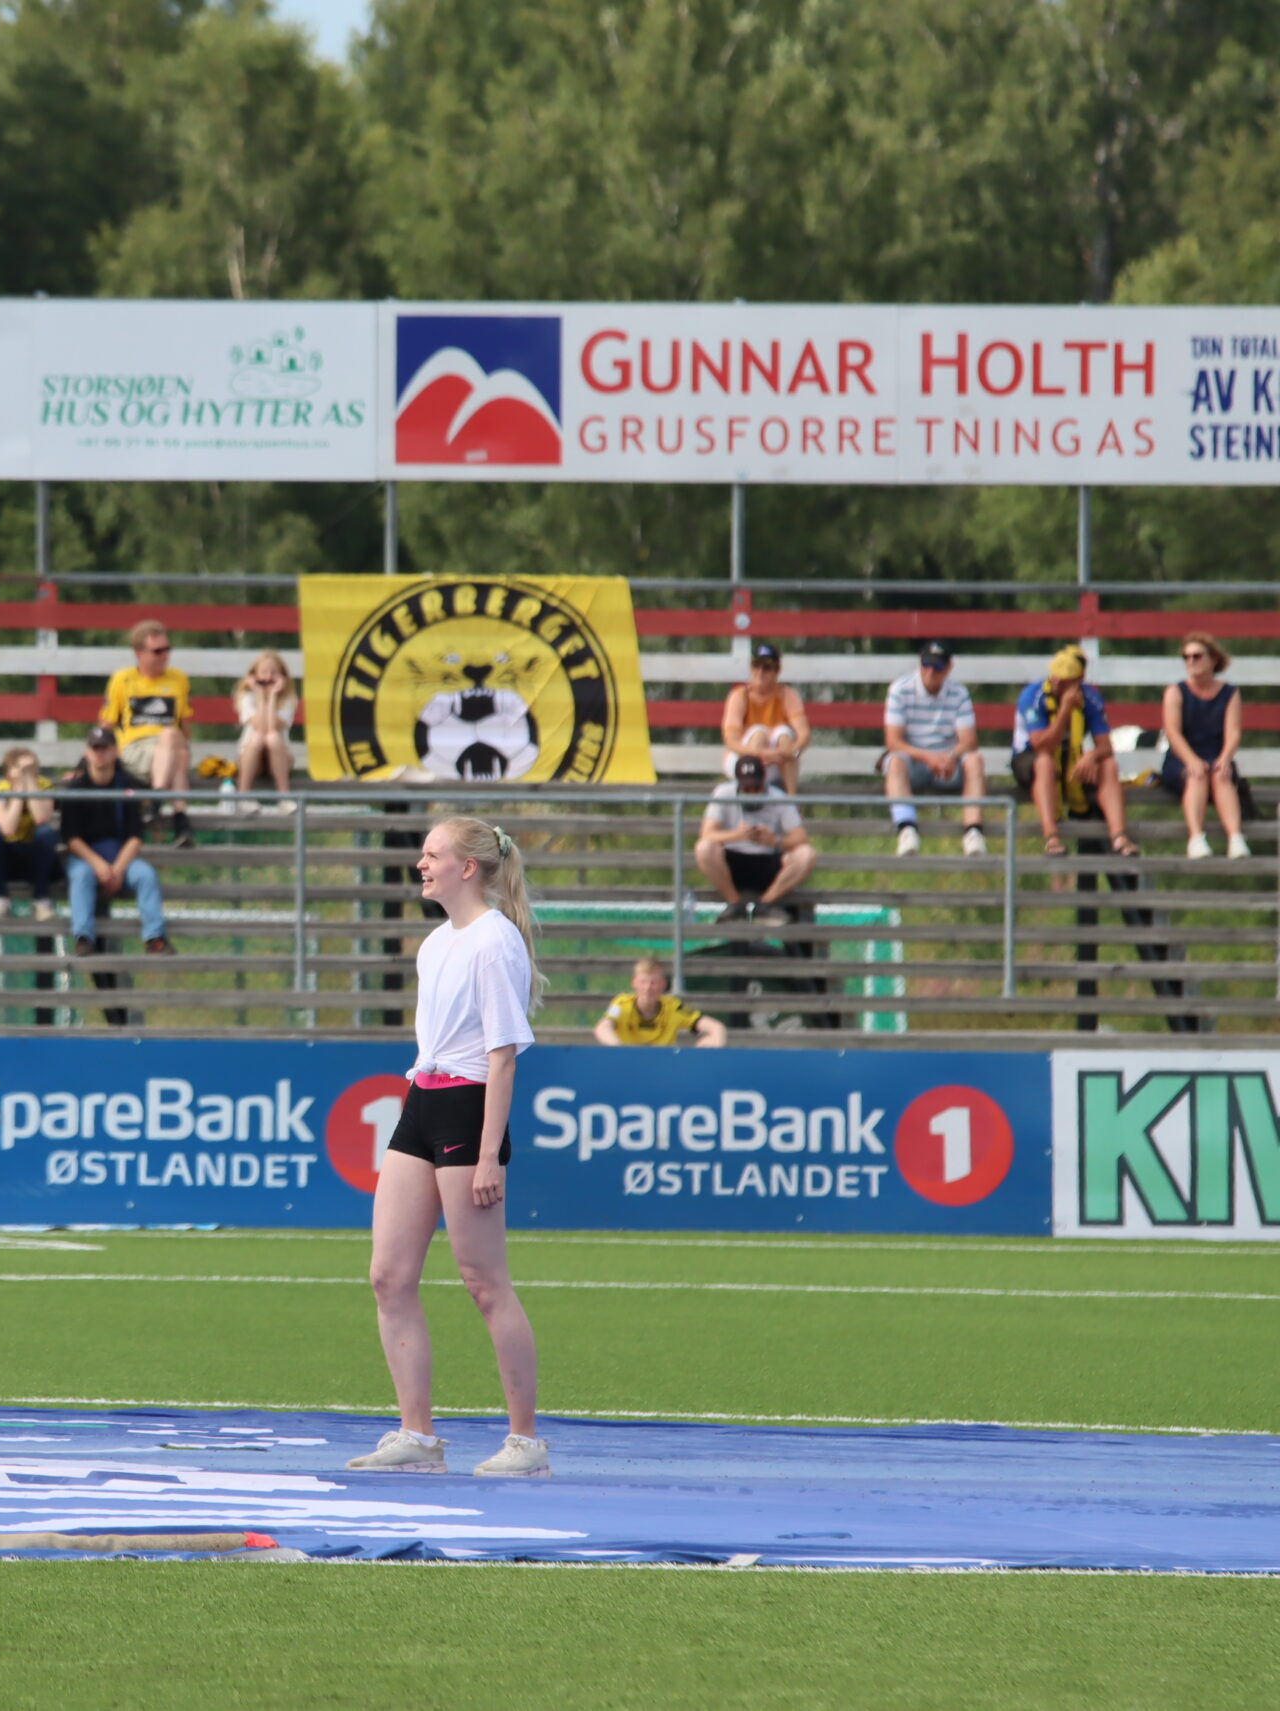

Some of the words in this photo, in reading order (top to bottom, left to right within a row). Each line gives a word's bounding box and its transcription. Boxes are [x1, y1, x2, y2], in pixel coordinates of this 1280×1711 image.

[579, 328, 878, 396] GUNNAR
[920, 331, 1156, 397] HOLTH
[41, 375, 193, 401] STORSJØEN
[1191, 368, 1237, 414] AV
[1252, 368, 1280, 414] K
[40, 400, 110, 427] HUS
[119, 400, 170, 427] OG
[181, 400, 313, 427] HYTTER
[322, 400, 366, 427] AS
[1189, 424, 1280, 461] STEIN
[345, 584, 600, 701] TIGERBERGET
[532, 1086, 886, 1161] SpareBank
[929, 1106, 972, 1184] 1
[47, 1150, 318, 1188] ØSTLANDET
[623, 1160, 889, 1198] ØSTLANDET
